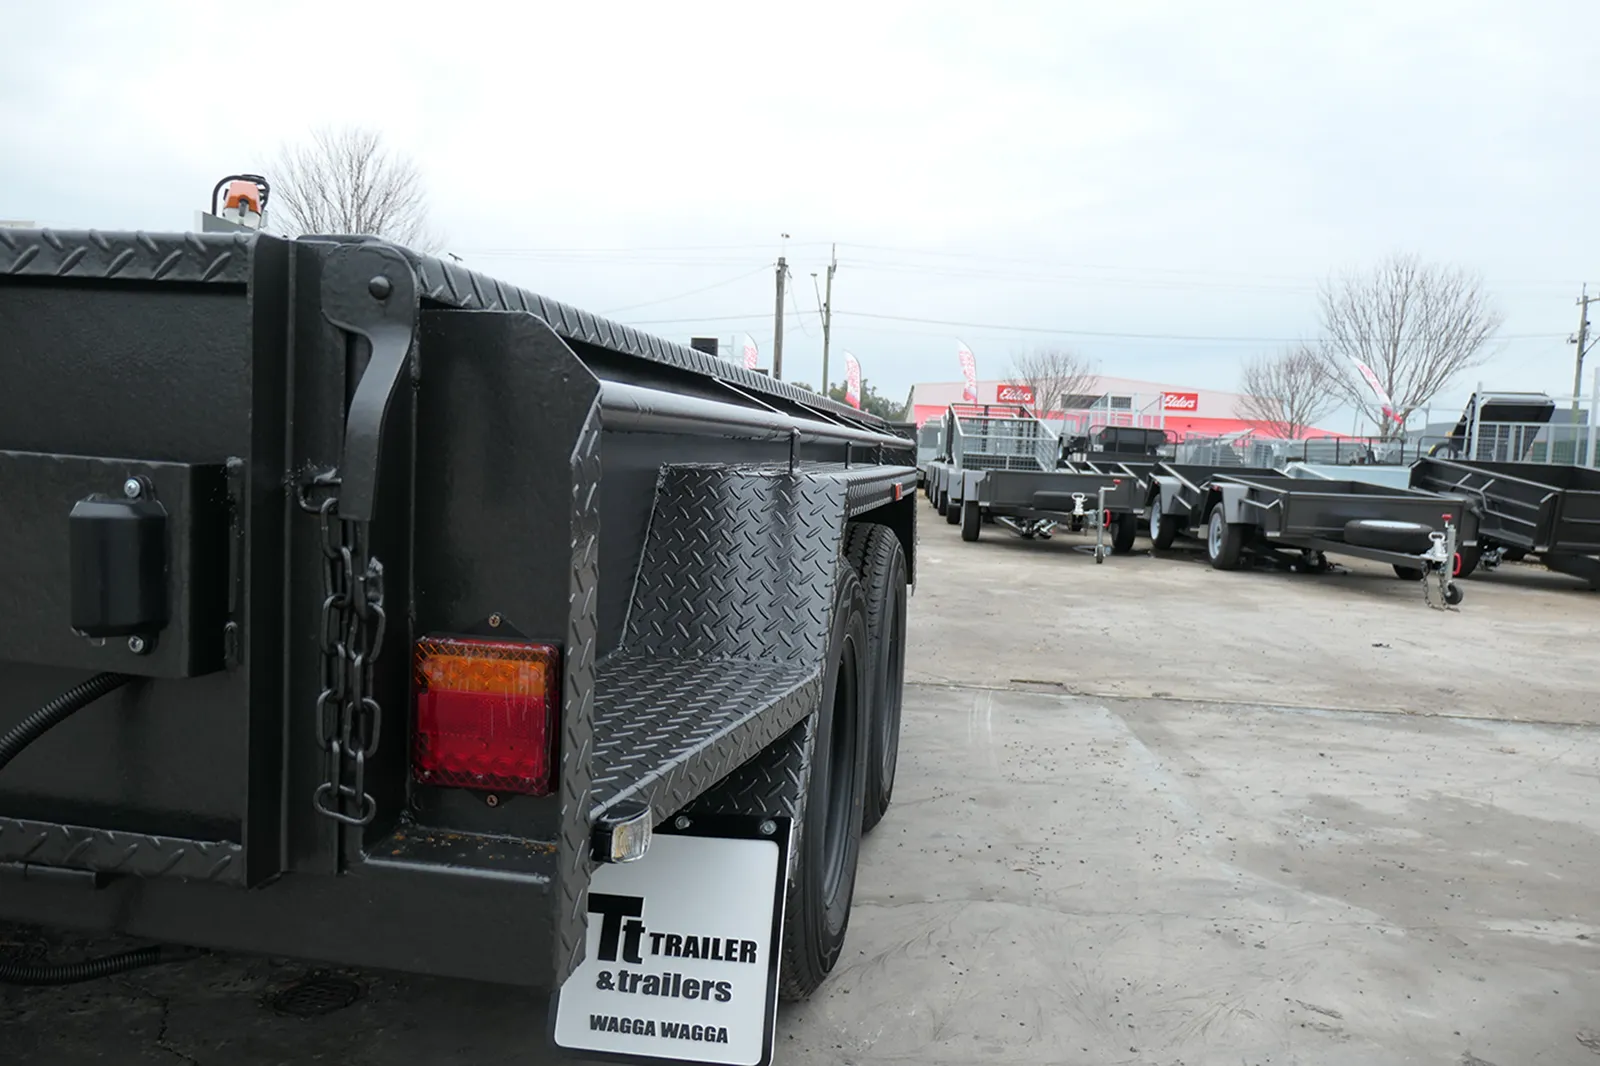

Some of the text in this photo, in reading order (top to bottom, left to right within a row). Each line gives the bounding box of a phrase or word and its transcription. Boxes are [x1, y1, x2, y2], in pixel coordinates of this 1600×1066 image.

[649, 932, 757, 964] TRAILER
[589, 1014, 728, 1044] WAGGA WAGGA
